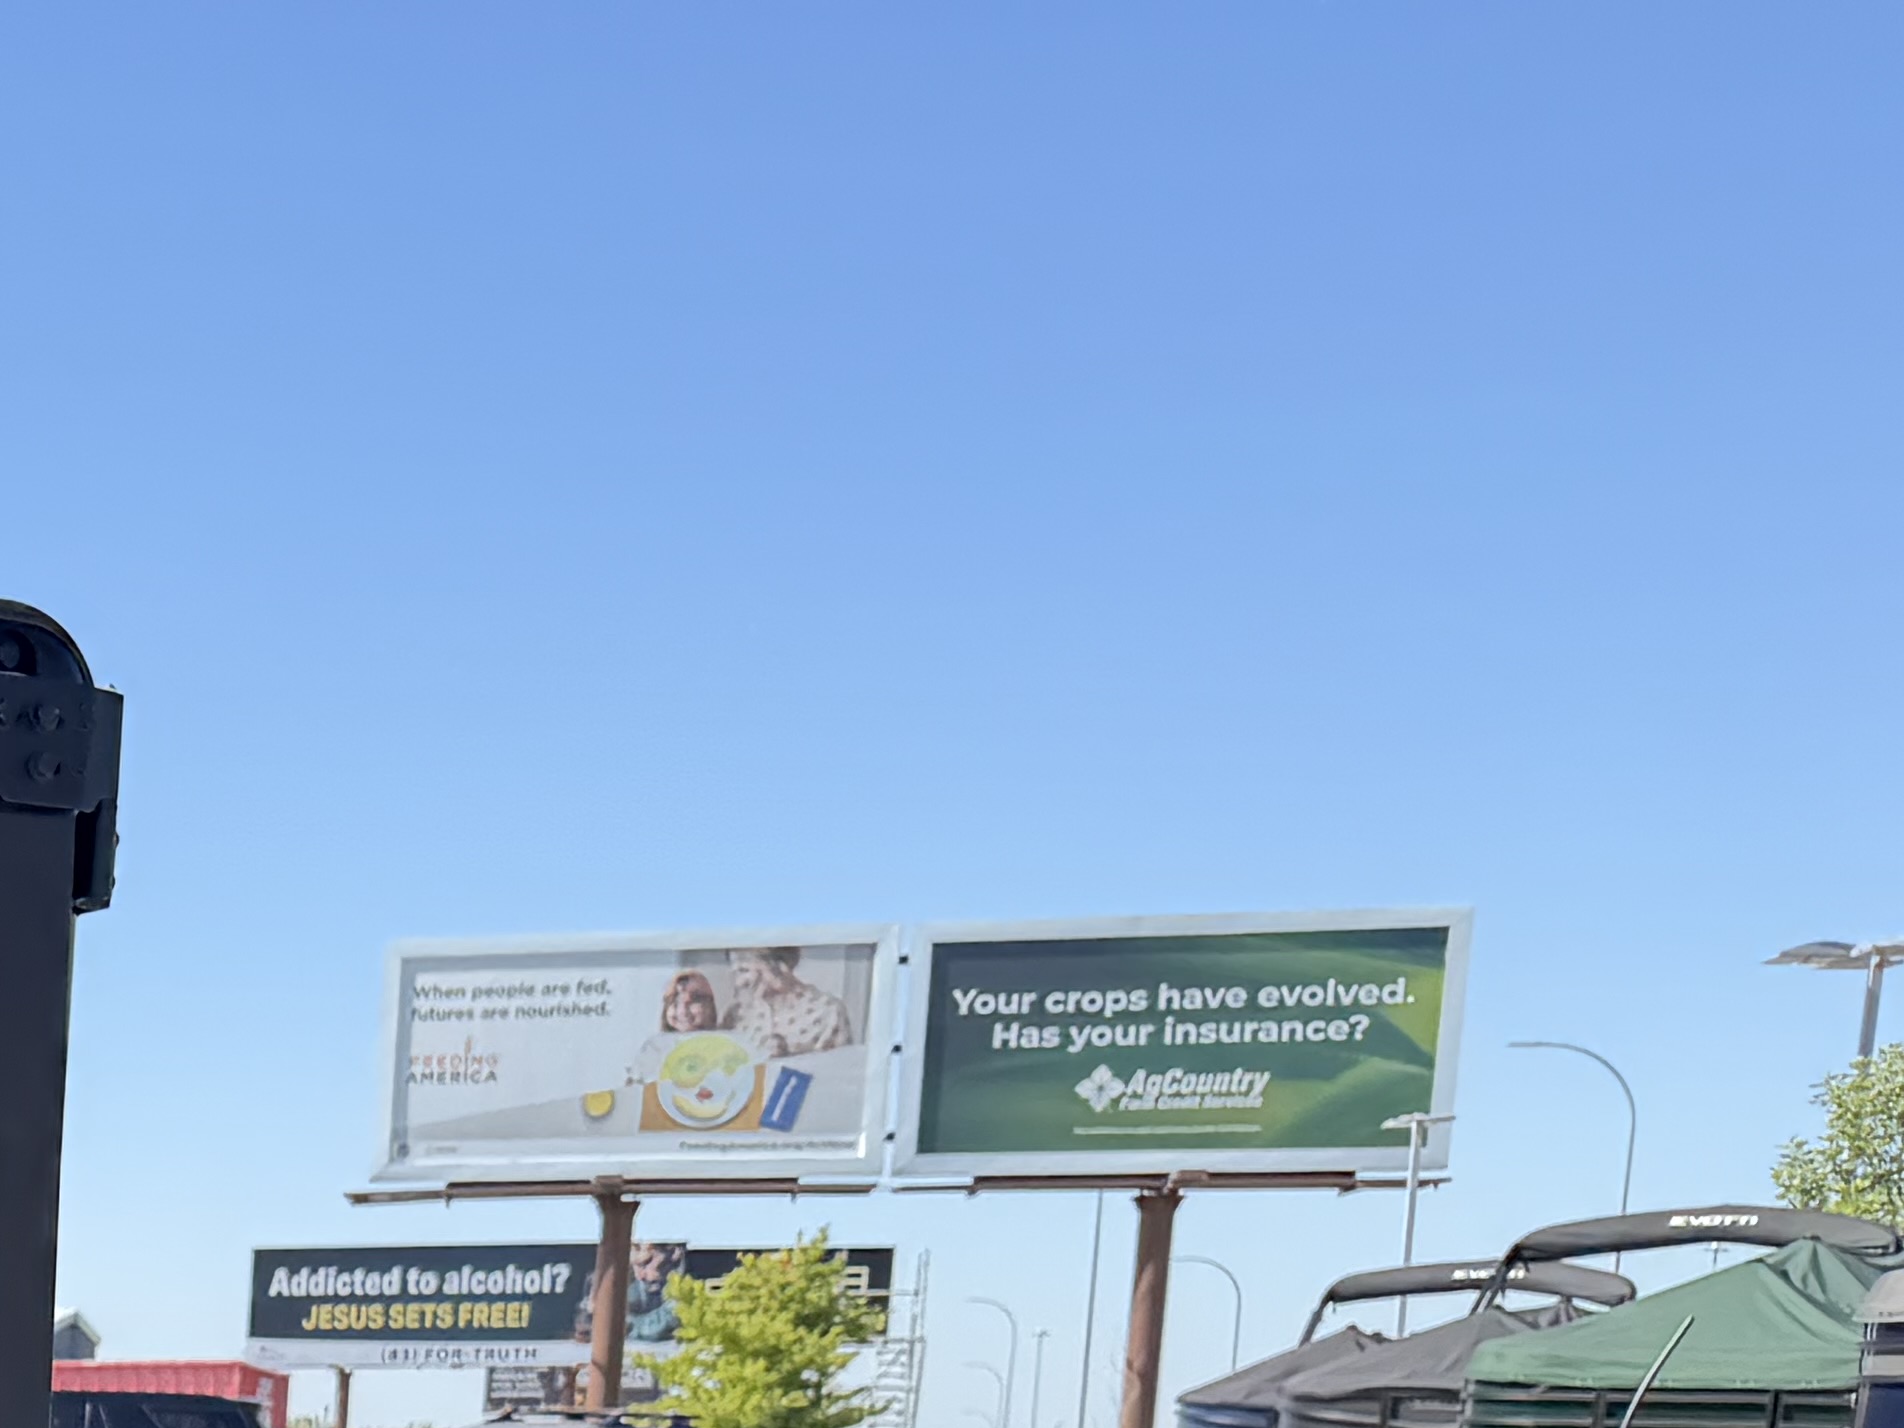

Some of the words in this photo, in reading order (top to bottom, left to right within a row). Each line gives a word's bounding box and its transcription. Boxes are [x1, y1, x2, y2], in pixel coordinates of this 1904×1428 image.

[413, 983, 466, 999] When
[471, 981, 535, 1000] people
[541, 982, 570, 996] are
[576, 978, 612, 996] fed.
[952, 987, 1033, 1015] Your
[1045, 986, 1147, 1018] crops
[1157, 982, 1248, 1011] have
[1257, 977, 1415, 1007] evolved.
[411, 1004, 474, 1022] futures
[480, 1006, 509, 1019] are
[514, 1000, 611, 1019] nourished.
[992, 1021, 1060, 1049] Has
[1068, 1024, 1154, 1053] your
[1164, 1015, 1370, 1045] insurance?
[405, 1069, 498, 1085] AMERICA
[1125, 1067, 1272, 1099] AgCountry
[268, 1265, 401, 1298] Addicted
[405, 1266, 438, 1296] to
[442, 1262, 572, 1295] alcohol?
[300, 1304, 385, 1331] JESUS
[387, 1304, 456, 1329] SETS
[457, 1302, 530, 1329] FREE!
